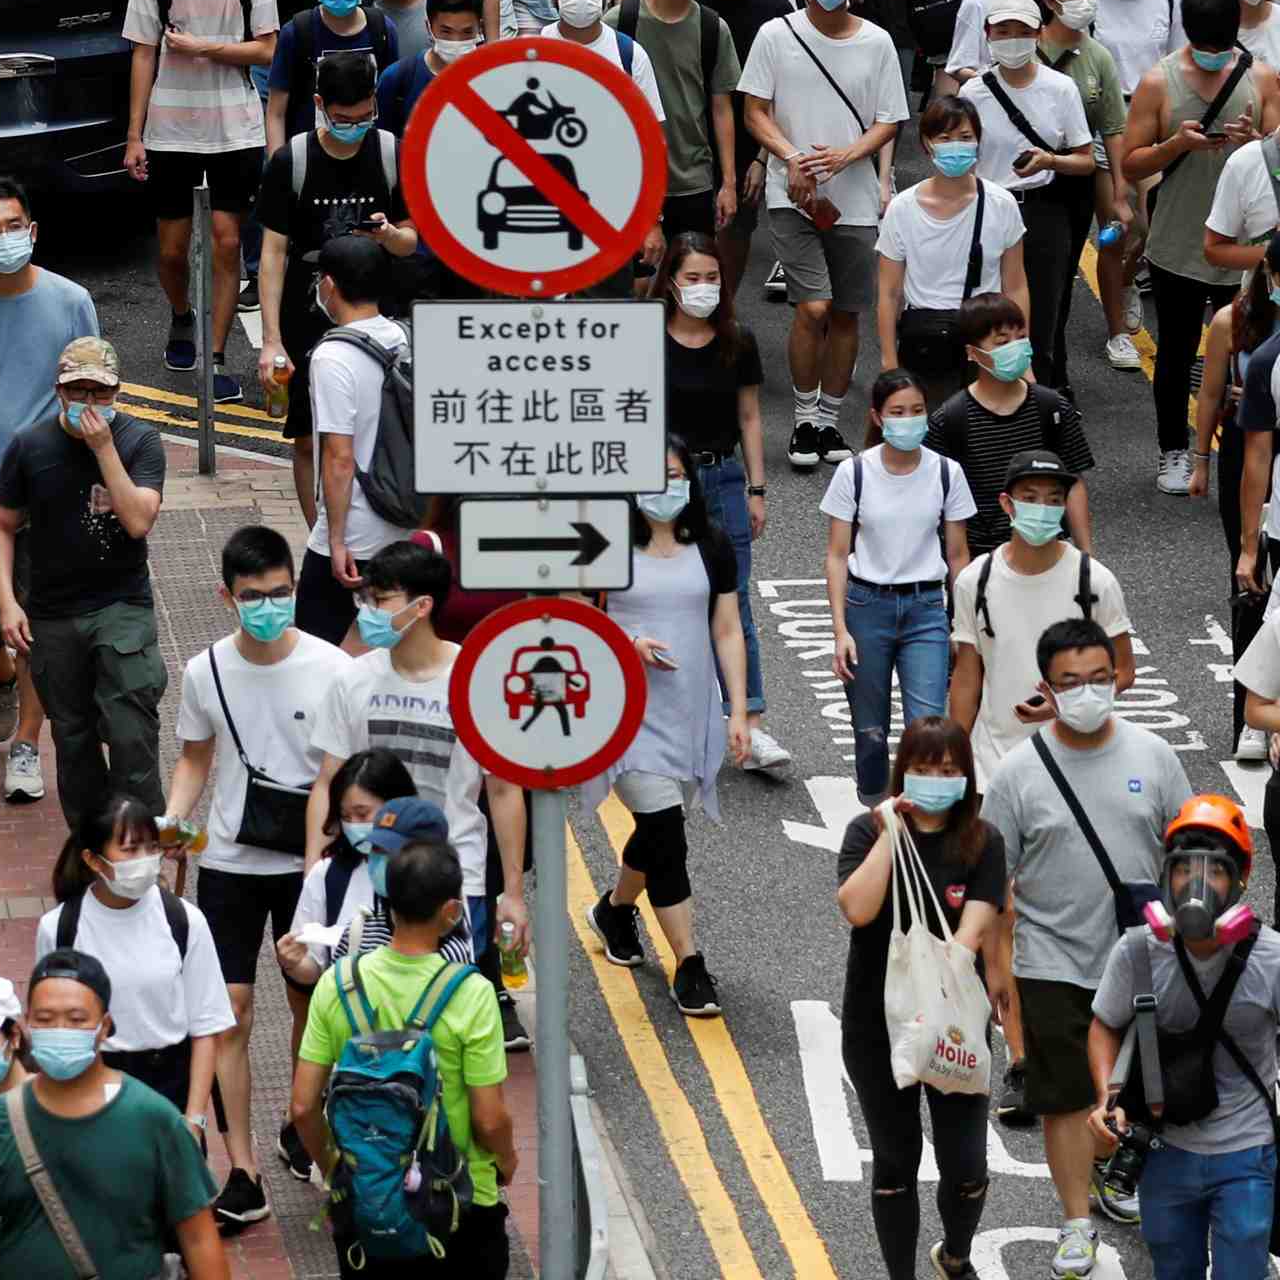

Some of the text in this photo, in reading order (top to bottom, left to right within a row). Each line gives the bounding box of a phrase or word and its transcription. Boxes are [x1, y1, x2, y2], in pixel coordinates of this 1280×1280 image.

[457, 314, 620, 343] Except for
[486, 351, 592, 373] access
[430, 387, 653, 426] 前往此區者
[452, 440, 630, 478] 不在此限
[935, 1036, 977, 1069] Holle
